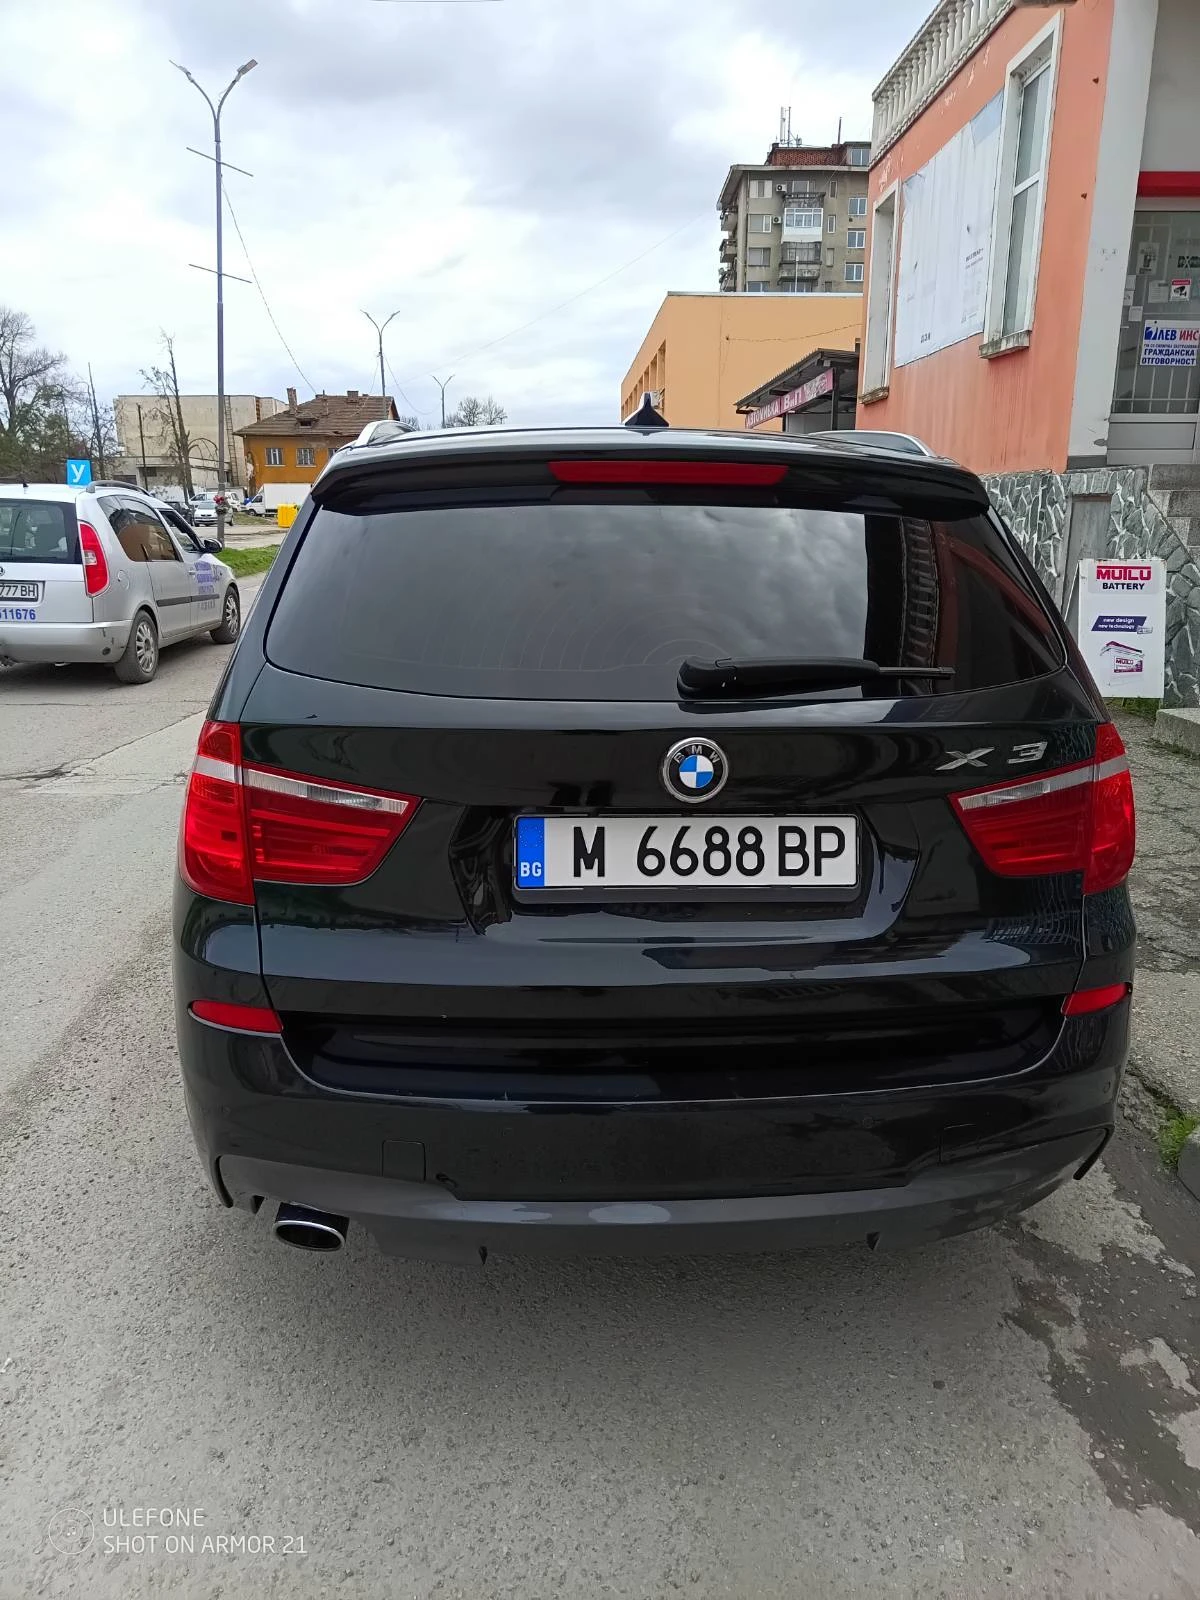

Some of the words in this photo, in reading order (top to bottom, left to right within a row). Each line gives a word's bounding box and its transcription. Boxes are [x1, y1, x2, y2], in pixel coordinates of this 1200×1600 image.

[1158, 329, 1177, 340] ЛЕВ
[1179, 329, 1199, 341] ИНС
[1144, 349, 1195, 357] ГРАЖДАНСКА
[1141, 357, 1196, 365] ОТГОВОРНОСТ
[1096, 565, 1152, 581] MUTLU
[1102, 582, 1145, 590] BATTERY
[0, 608, 36, 620] 11676
[673, 744, 721, 764] BMW
[573, 826, 606, 878] M
[520, 861, 542, 877] BG
